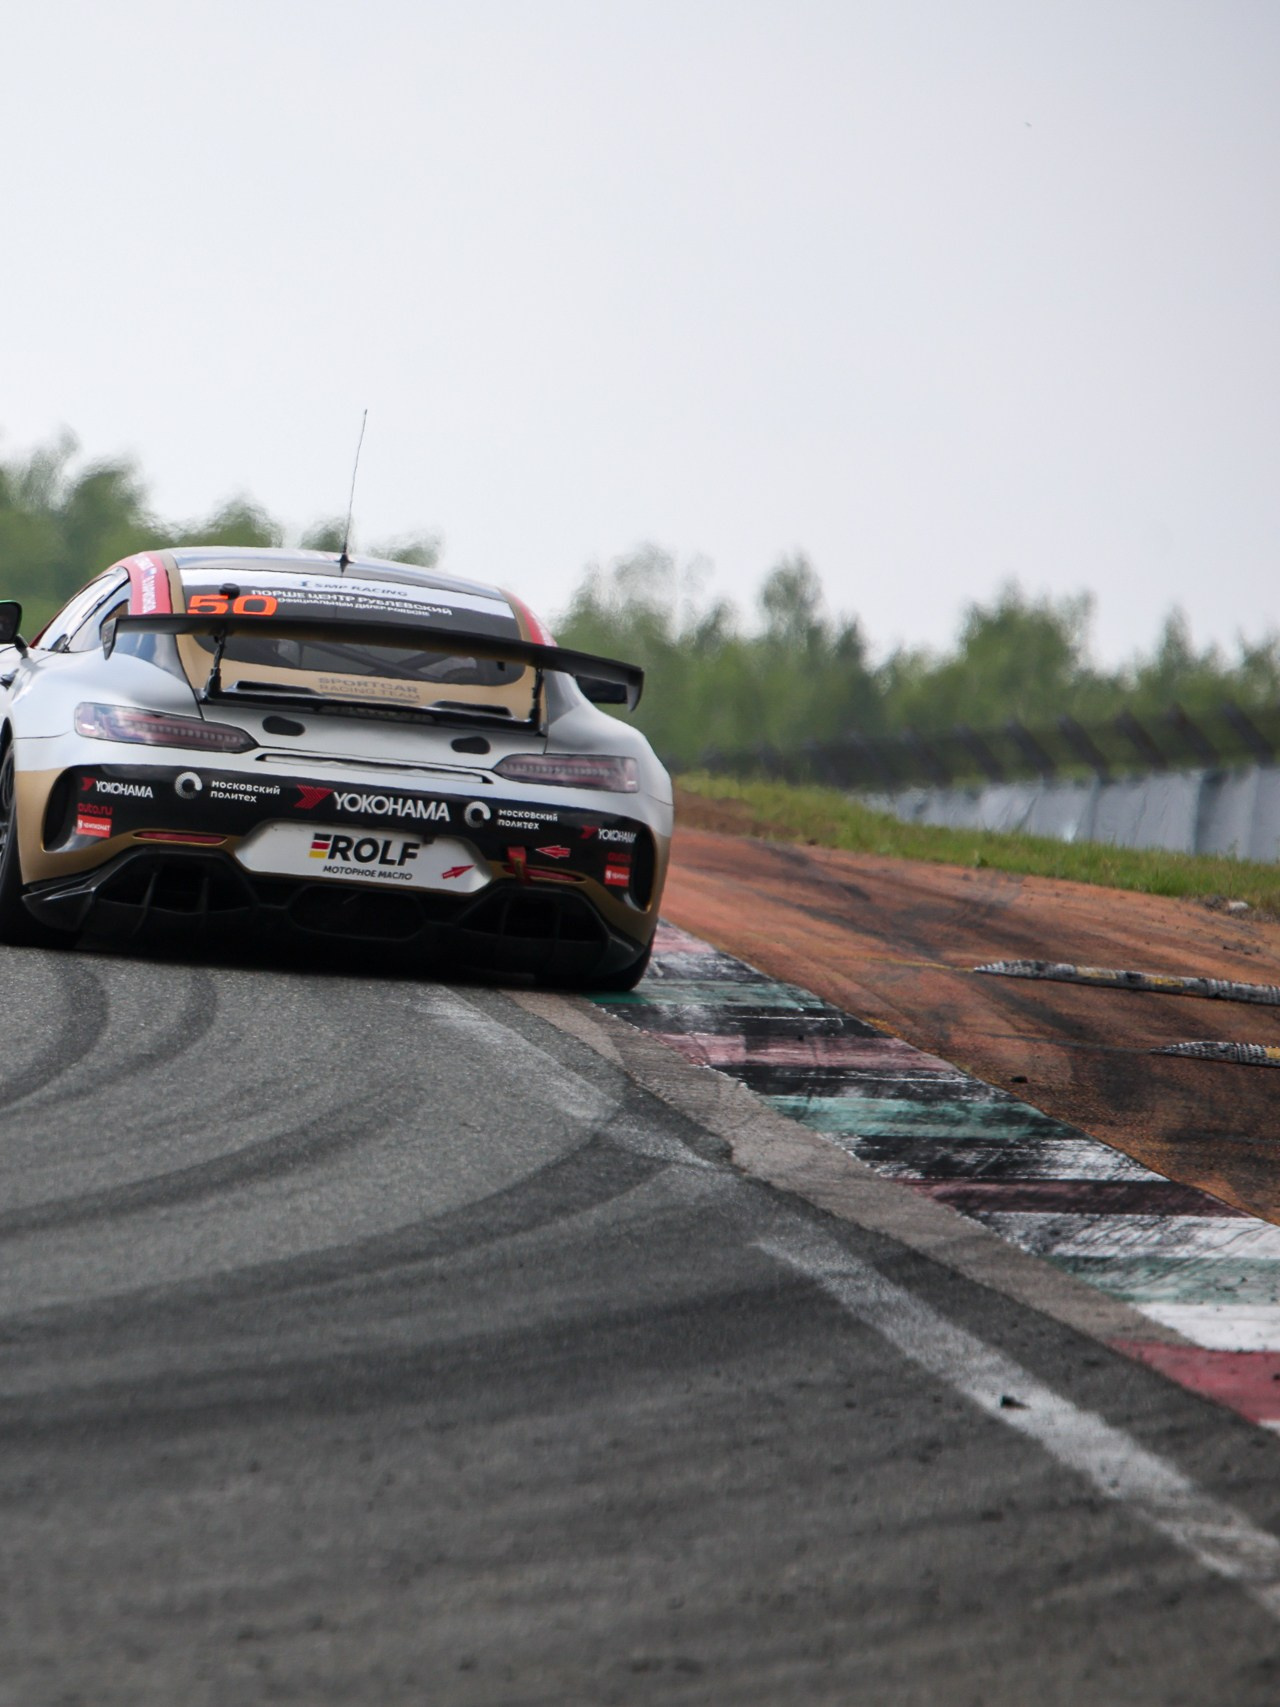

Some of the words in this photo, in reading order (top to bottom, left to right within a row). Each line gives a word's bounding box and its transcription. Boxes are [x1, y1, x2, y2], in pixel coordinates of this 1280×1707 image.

[351, 585, 409, 597] RACING
[186, 593, 278, 616] 50
[250, 589, 306, 600] ПОРШЕ
[308, 592, 356, 603] ЦЕНТР
[357, 596, 454, 616] РУБЛЕВСКИЙ
[318, 677, 419, 694] SPORTCAR
[319, 684, 376, 695] RACING
[380, 688, 421, 700] TEAM
[95, 780, 154, 798] YOKOHAMA
[333, 791, 451, 822] YOKOHAMA
[327, 834, 421, 867] ROLF
[322, 865, 377, 878] МОТОРНОЕ
[377, 871, 413, 881] МАСЛО
